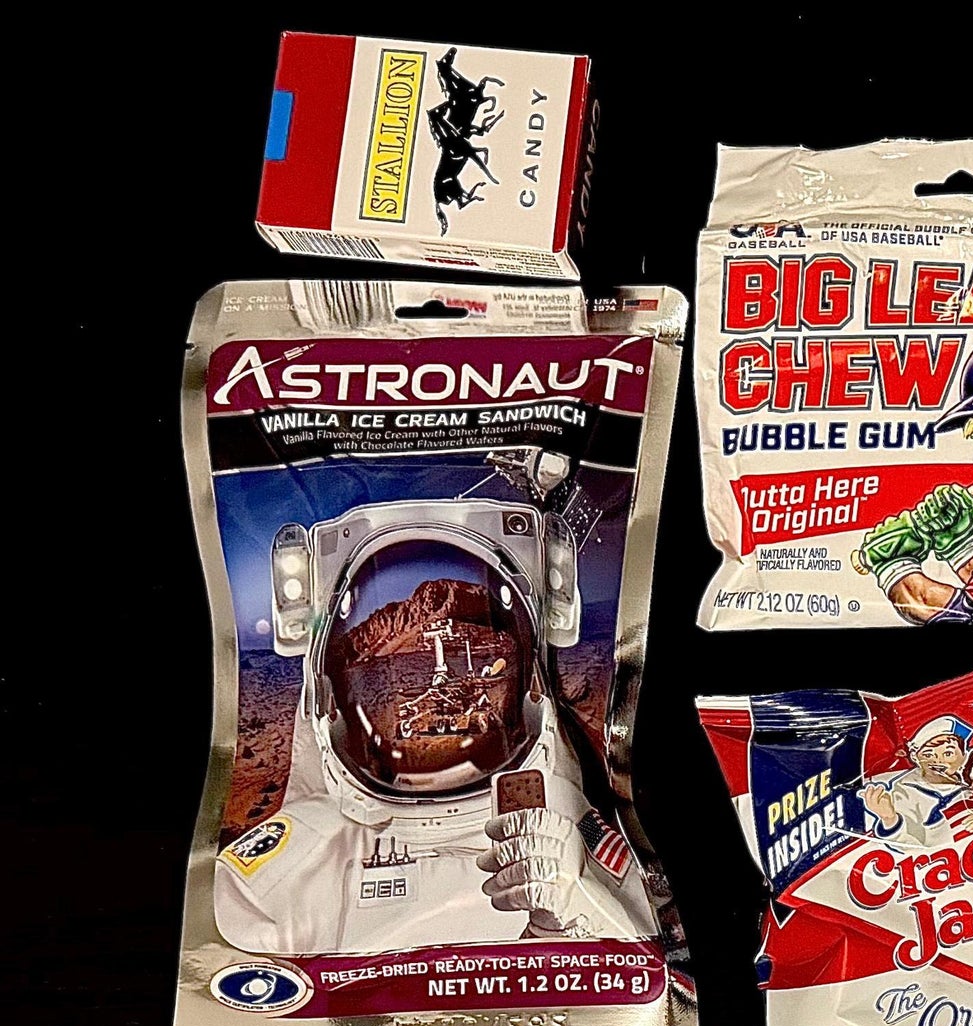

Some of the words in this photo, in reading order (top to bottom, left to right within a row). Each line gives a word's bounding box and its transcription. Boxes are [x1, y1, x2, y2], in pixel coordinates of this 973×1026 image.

[370, 55, 418, 215] STALLION
[519, 88, 548, 208] CANDY
[821, 231, 838, 241] OF
[842, 232, 868, 244] USA
[871, 232, 940, 247] BASEBALL
[721, 253, 857, 333] BIG
[213, 345, 634, 404] ASTRONAUT
[720, 334, 968, 413] CHEW
[262, 413, 340, 433] VANILLA
[351, 414, 386, 428] ICE
[395, 412, 467, 428] CREAM
[478, 404, 587, 427] SANDWICH
[283, 432, 314, 445] Vanilla
[317, 430, 363, 440] Flavored
[384, 431, 419, 440] Cream
[482, 424, 521, 435] Natural
[523, 422, 563, 435] Flavors
[361, 440, 413, 450] Chocolate
[417, 438, 463, 449] Flavored
[722, 422, 849, 456] BUBBLE
[859, 422, 937, 450] GUM
[814, 475, 879, 501] Here
[752, 497, 862, 534] Original
[760, 548, 808, 559] NATURALLY
[809, 548, 827, 559] AND
[797, 560, 842, 571] FLAVORED
[768, 769, 831, 835] PRIZE
[768, 795, 844, 879] INSIDE!
[320, 963, 428, 985] FREEZE-DRIED
[435, 957, 545, 973] READY-TO-EAT
[551, 954, 599, 968] SPACE
[606, 954, 647, 966] FOOD
[428, 979, 469, 996] NET
[475, 977, 511, 994] WT.
[517, 976, 548, 993] 1.2
[554, 974, 587, 991] OZ.
[593, 972, 624, 993] (34
[875, 981, 927, 1025] The
